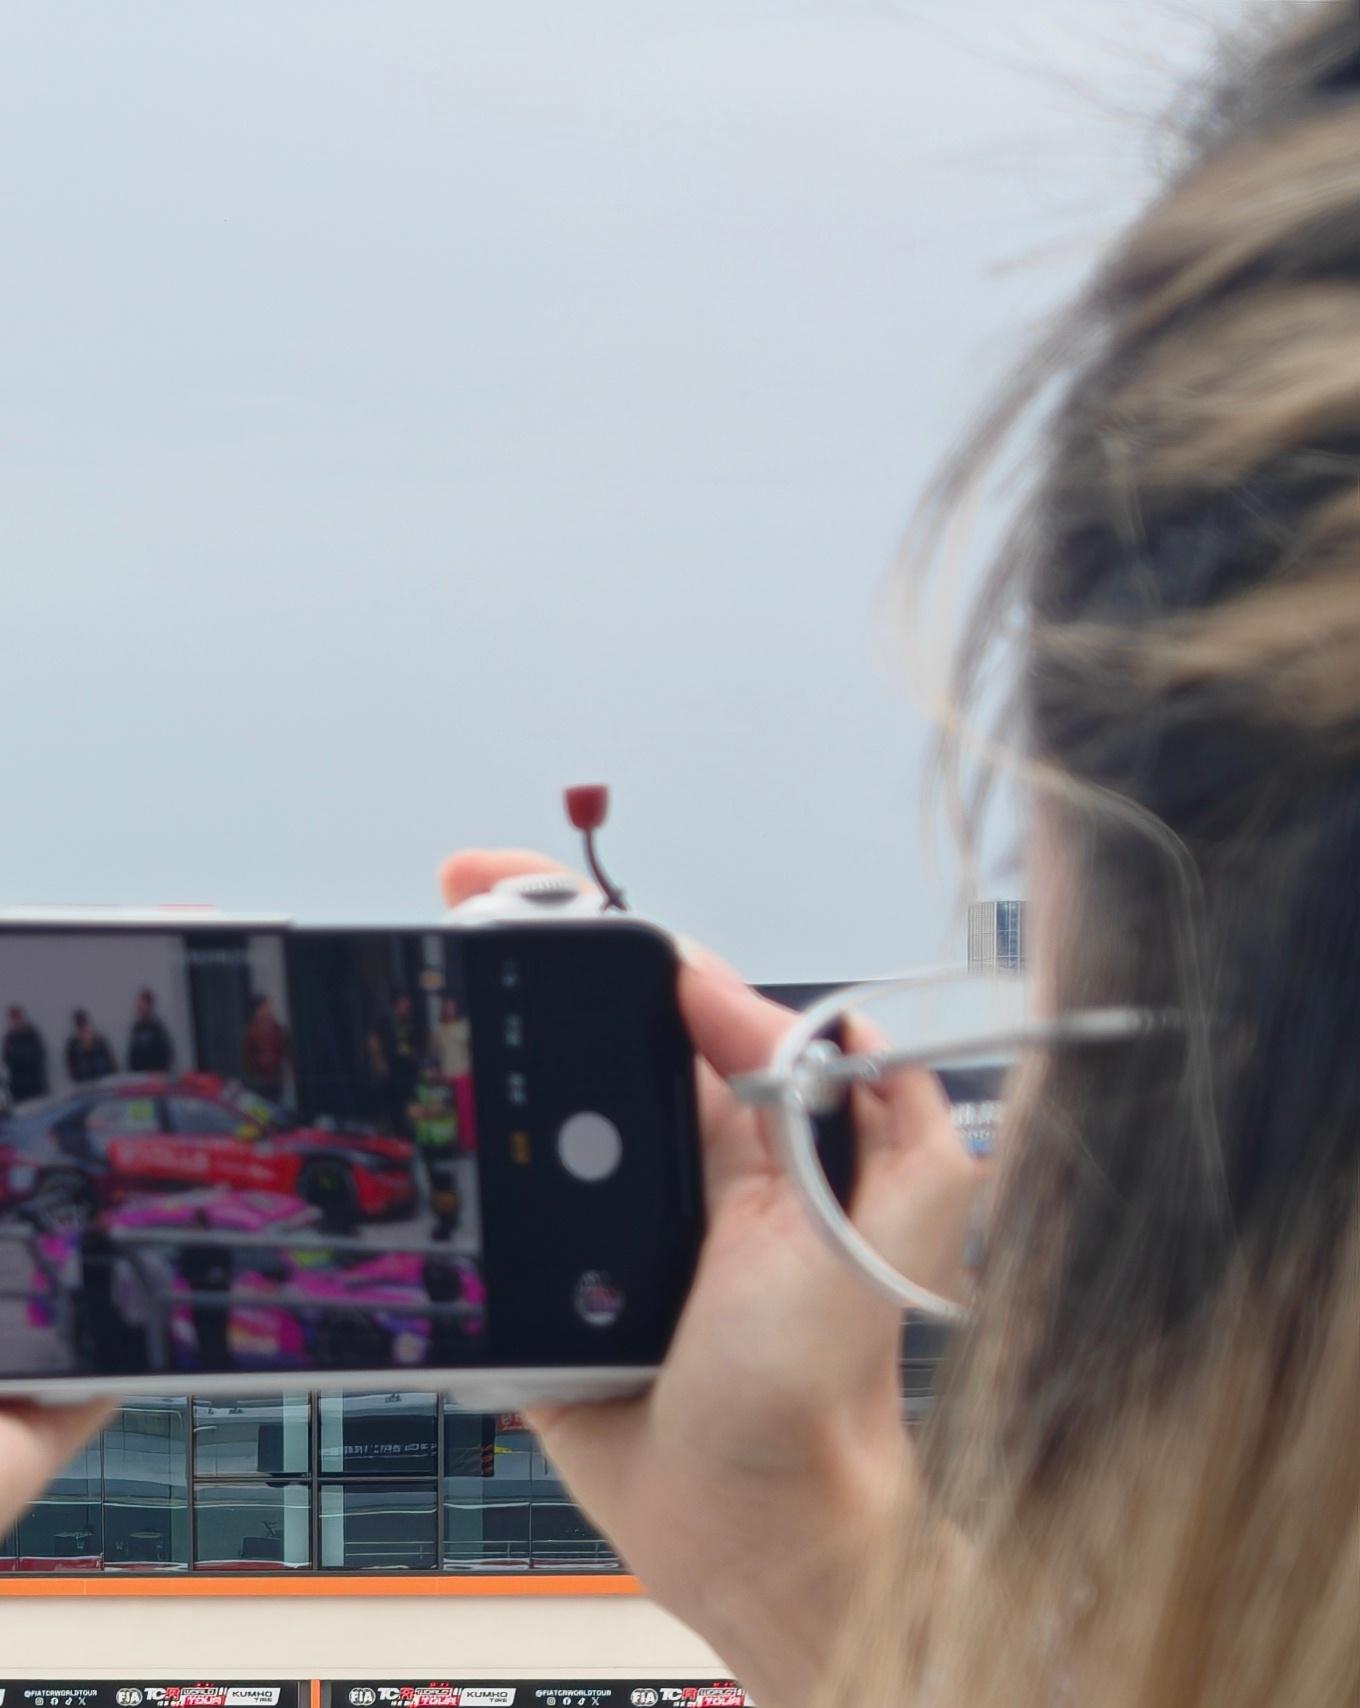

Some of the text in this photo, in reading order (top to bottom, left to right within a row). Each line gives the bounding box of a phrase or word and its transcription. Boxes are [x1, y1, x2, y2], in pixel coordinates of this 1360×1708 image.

[144, 1687, 180, 1700] TCR
[232, 1690, 273, 1698] KUMHO
[377, 1687, 415, 1700] TCR
[659, 1687, 697, 1701] TCR
